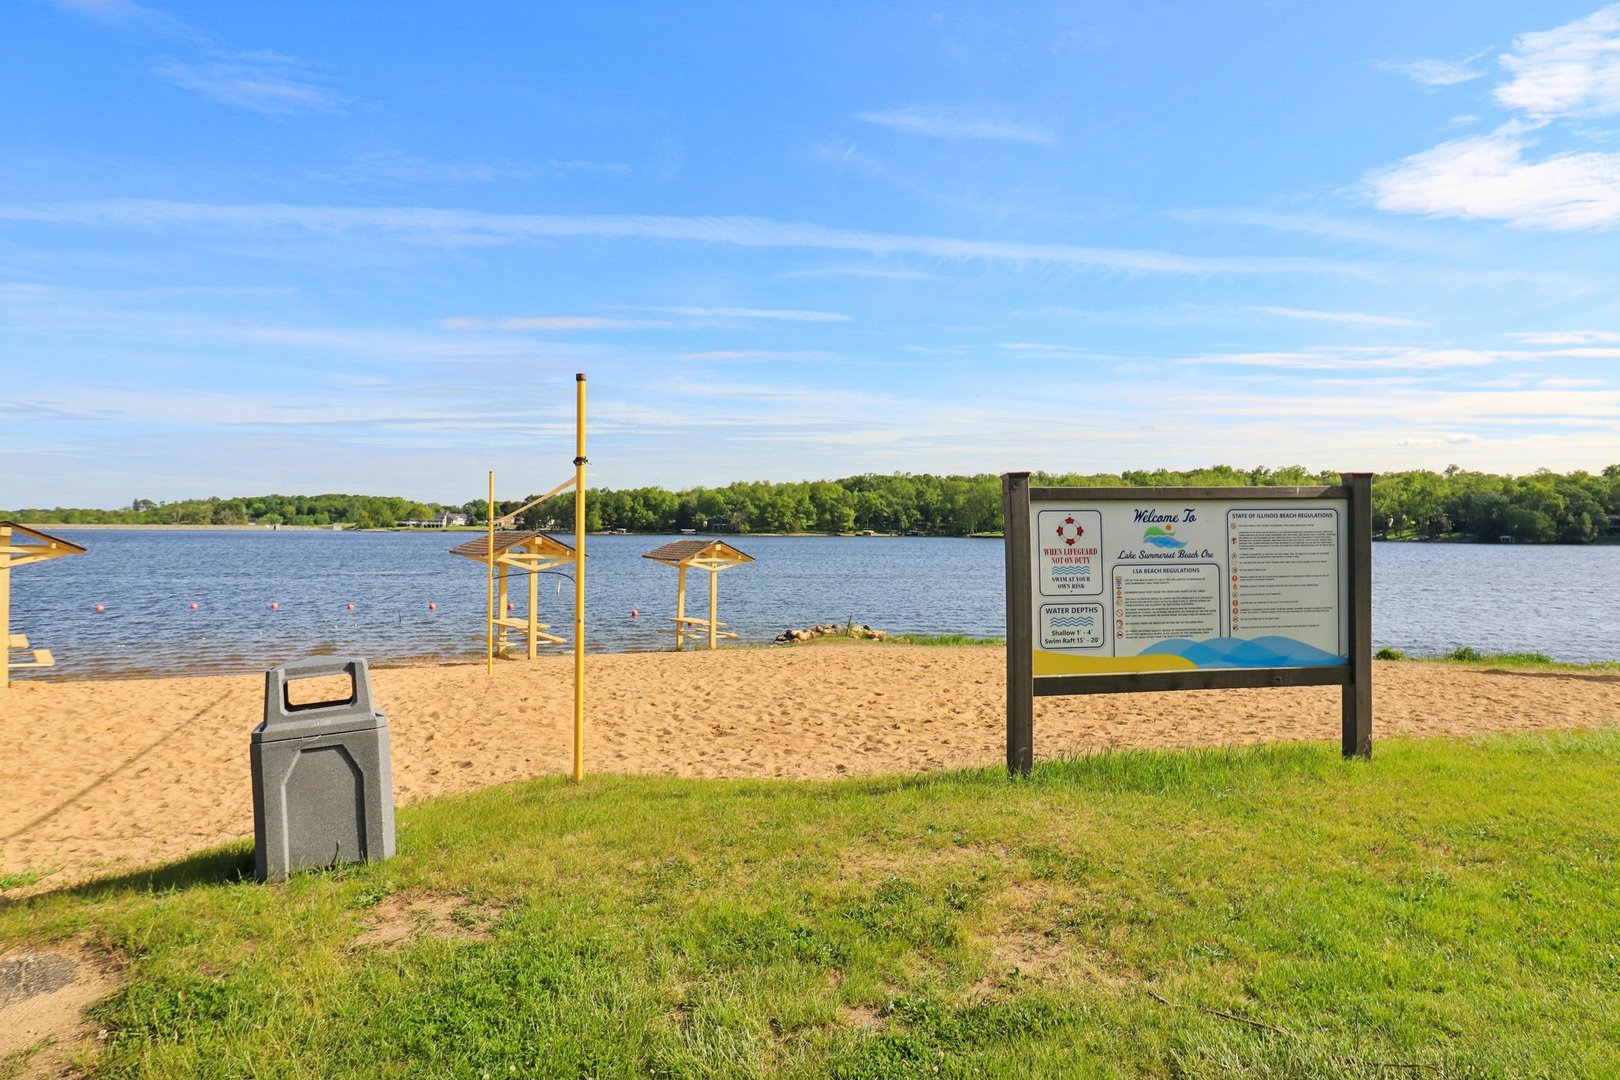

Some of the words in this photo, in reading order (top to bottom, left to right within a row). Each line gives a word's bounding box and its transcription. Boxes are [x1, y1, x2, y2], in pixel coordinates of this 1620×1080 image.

[1133, 508, 1179, 523] Welcome
[1182, 508, 1197, 523] To
[1118, 550, 1136, 560] Lake
[1138, 550, 1175, 559] Summerset
[1178, 550, 1198, 558] Beach
[1201, 549, 1214, 558] One
